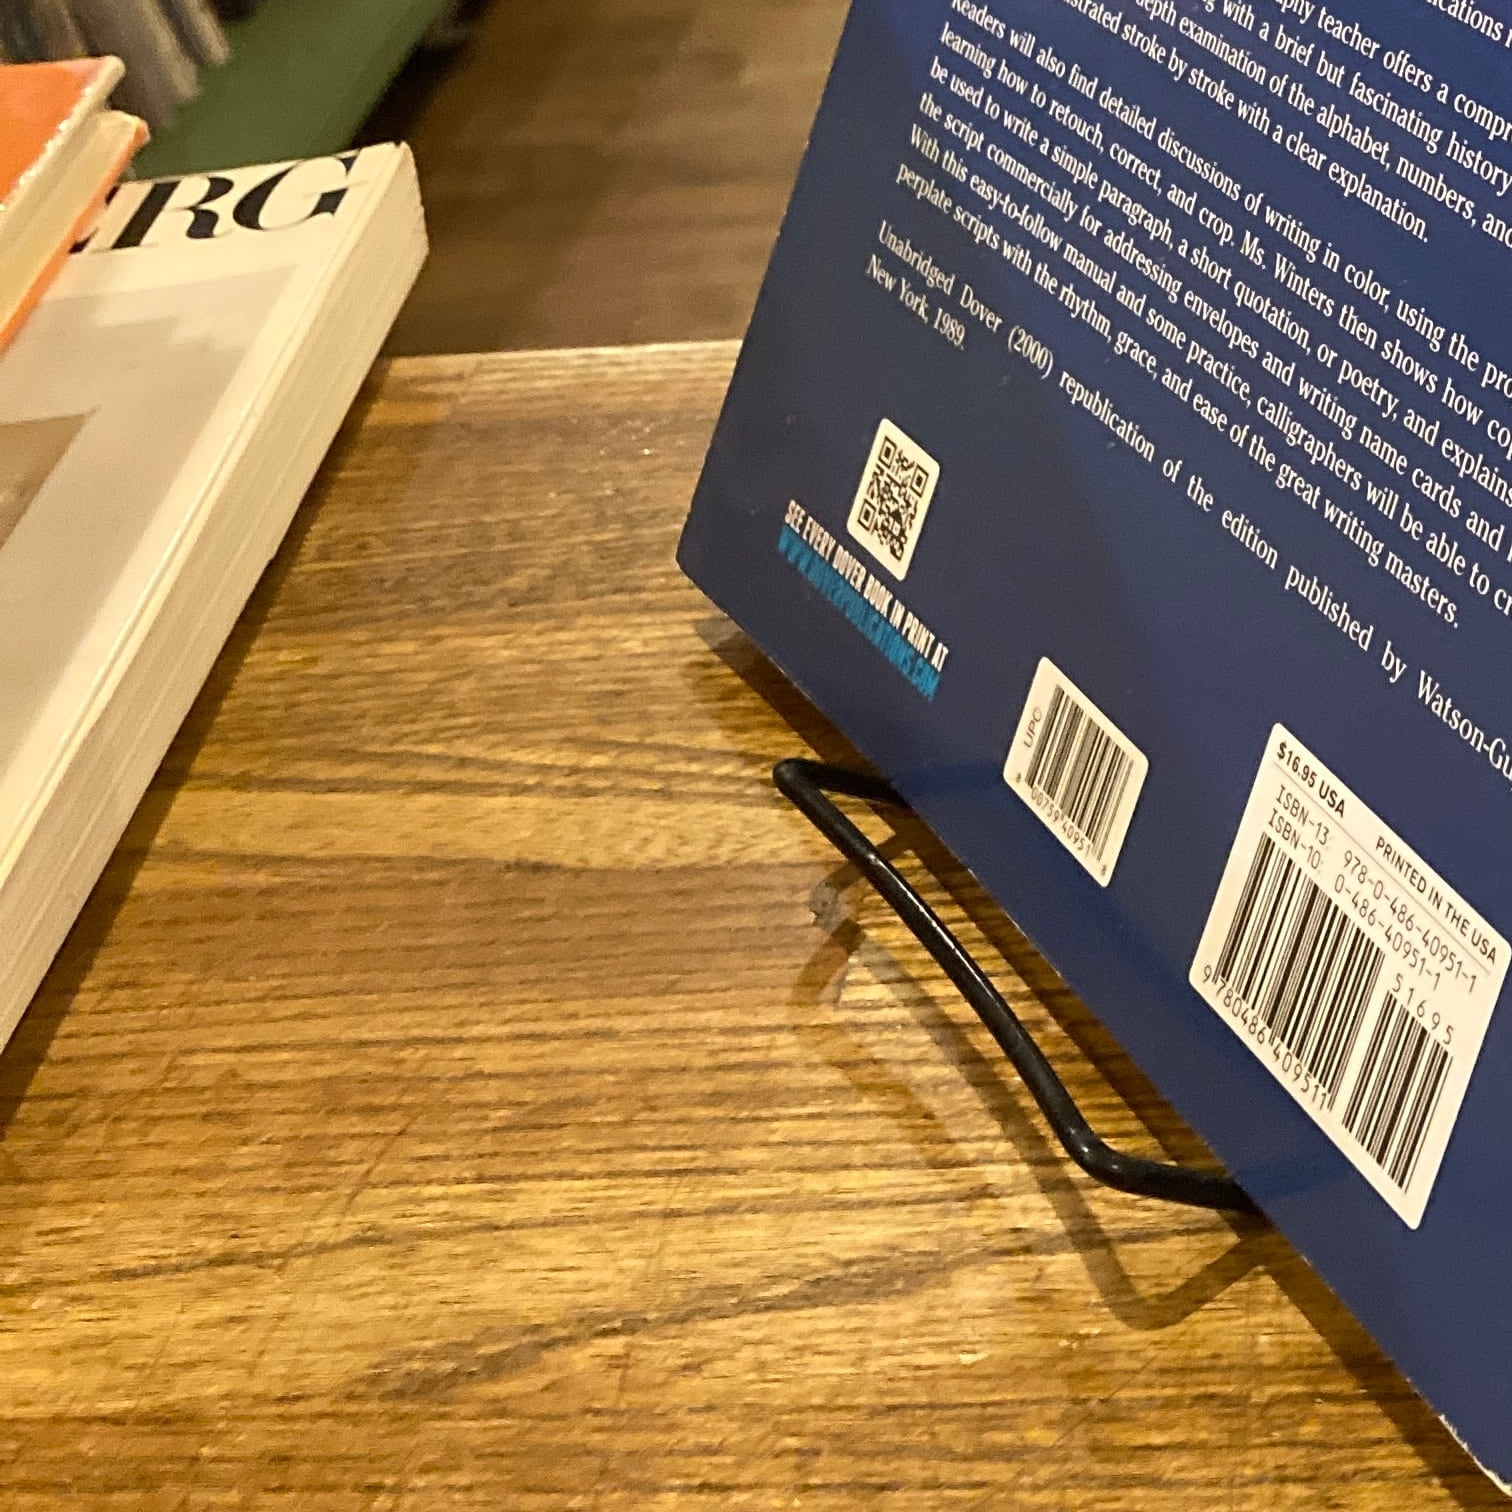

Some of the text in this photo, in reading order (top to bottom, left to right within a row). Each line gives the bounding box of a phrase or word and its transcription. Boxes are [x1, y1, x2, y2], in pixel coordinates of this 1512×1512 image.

[1257, 21, 1271, 44] a
[1272, 23, 1316, 69] brief
[1314, 49, 1346, 91] but
[1347, 71, 1445, 157] fascinating
[1316, 6, 1382, 61] teacher
[1381, 49, 1435, 95] offers
[1435, 82, 1450, 106] a
[1119, 23, 1168, 66] stroke
[1166, 46, 1190, 84] by
[1186, 67, 1236, 113] stroke
[1236, 99, 1272, 138] with
[1270, 123, 1285, 147] a
[1284, 131, 1329, 173] clear
[1327, 161, 1429, 245] explanation.
[69, 146, 360, 254] RG
[864, 253, 967, 352] New York, 1989.
[918, 92, 944, 124] the
[942, 113, 986, 155] script
[985, 143, 1080, 225] commercially
[1078, 204, 1104, 239] for
[1102, 228, 1184, 306] addressing
[1182, 290, 1261, 361] envelopes
[1260, 351, 1297, 389] and
[1297, 376, 1359, 443] writing
[1358, 425, 1409, 478] name
[1410, 468, 1463, 521] cards
[1464, 511, 1507, 554] and
[877, 219, 957, 298] Unabridged
[958, 283, 1004, 335] Dover
[1006, 325, 1055, 382] (2000)
[1057, 370, 1156, 465] republication
[1161, 459, 1184, 486] of
[1185, 474, 1215, 514] the
[1220, 510, 1279, 572] edition
[1282, 565, 1375, 655] published
[1379, 640, 1409, 686] by
[802, 515, 837, 561] EVERY
[889, 599, 906, 631] IN
[902, 611, 936, 659] PRINT
[931, 641, 949, 673] AT
[1277, 741, 1346, 819] $16.95 USA
[1333, 873, 1441, 991] 0-486-40951-1
[1343, 849, 1477, 994] 978-0-486-40951-1
[1375, 835, 1497, 965] PRINTED IN THE USA
[1391, 972, 1455, 1045] 51695
